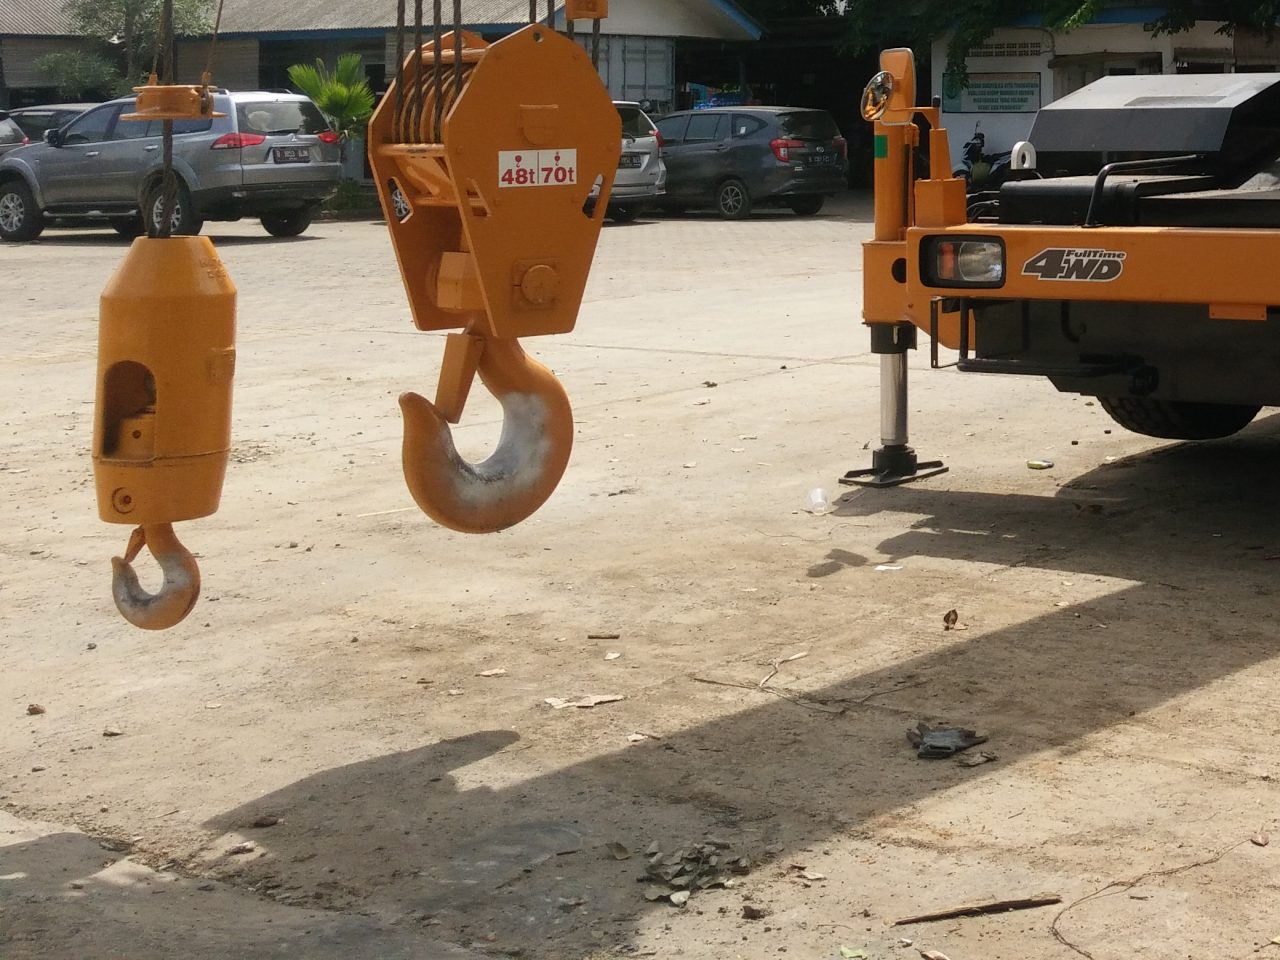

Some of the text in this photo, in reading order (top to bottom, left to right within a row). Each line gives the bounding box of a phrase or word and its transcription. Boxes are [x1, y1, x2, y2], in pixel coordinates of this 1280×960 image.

[501, 166, 574, 185] 48t 70t
[1023, 248, 1122, 280] 4WD
